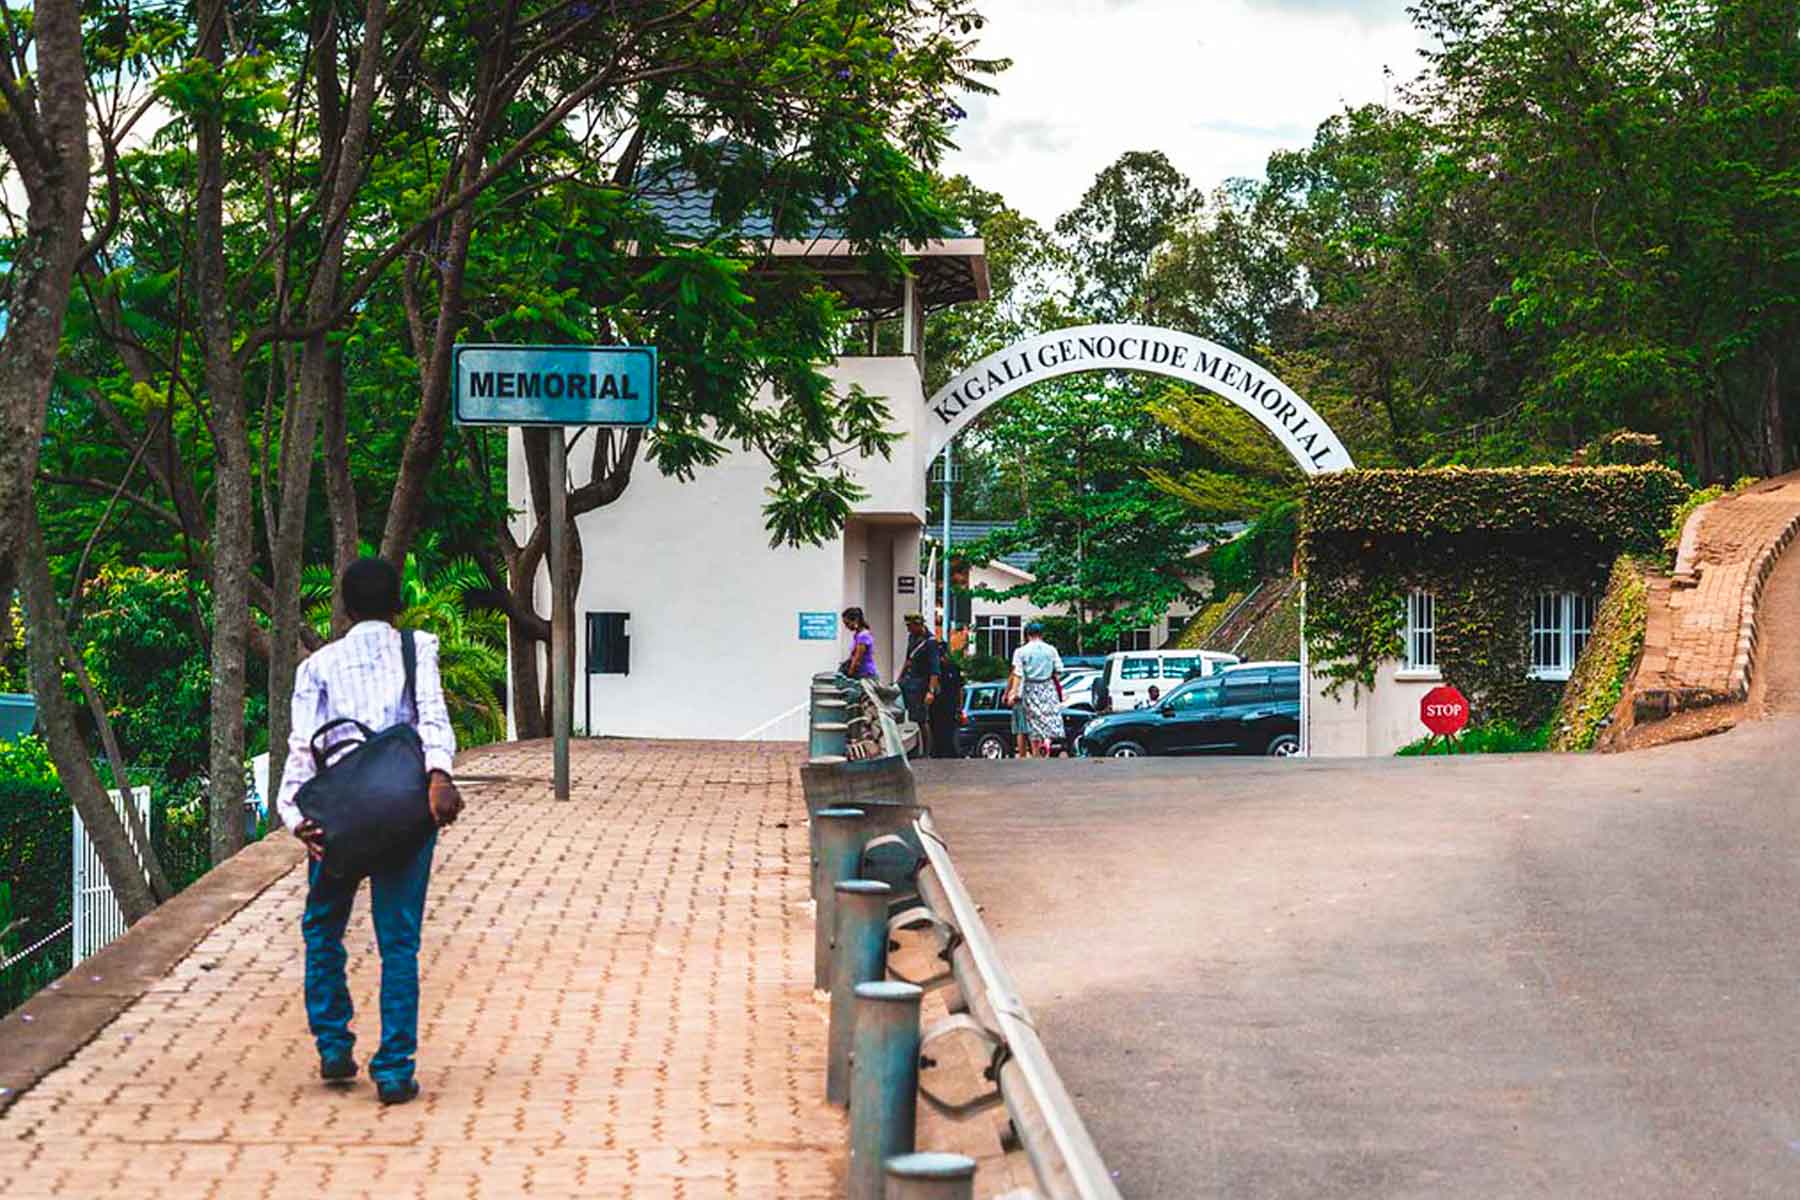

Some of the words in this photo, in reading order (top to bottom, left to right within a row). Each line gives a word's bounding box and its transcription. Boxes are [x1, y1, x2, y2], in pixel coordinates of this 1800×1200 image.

[470, 372, 639, 400] MEMORIAL
[934, 352, 1033, 424] KIGALI
[1038, 336, 1188, 368] GENOCIDE
[1196, 353, 1333, 470] MEMORIAL
[1426, 704, 1462, 717] STOP
